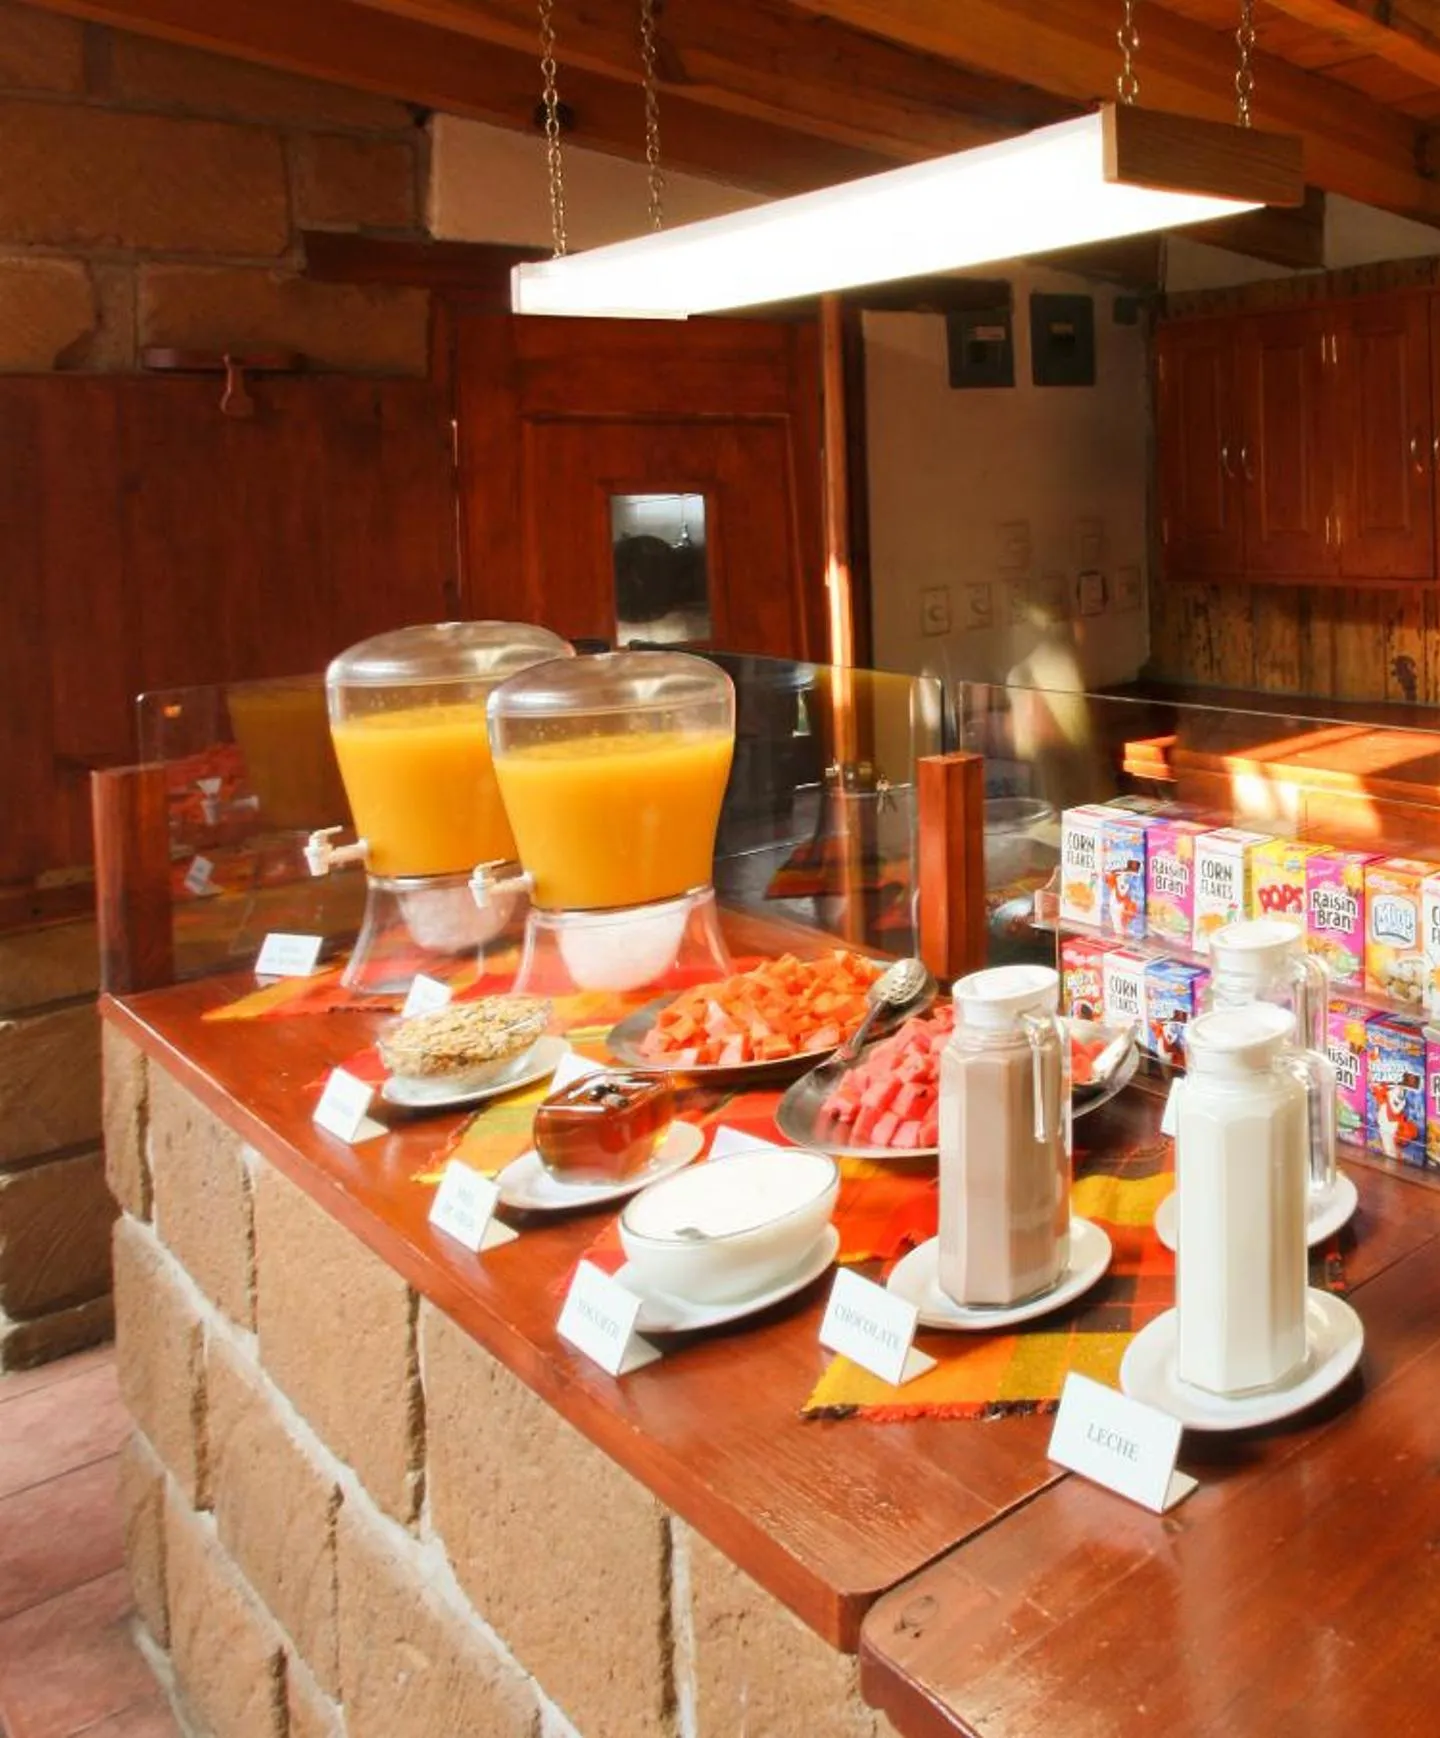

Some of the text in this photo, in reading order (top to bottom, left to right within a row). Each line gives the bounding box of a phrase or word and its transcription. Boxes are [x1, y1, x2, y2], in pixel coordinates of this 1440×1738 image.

[1067, 831, 1095, 851] CORN
[1066, 850, 1095, 869] FLAKES
[1151, 858, 1187, 881] Raisin
[1201, 859, 1232, 881] CORN
[1155, 875, 1184, 895] Bran
[1200, 878, 1233, 900] FLAKES
[1257, 883, 1304, 914] POPS
[1312, 890, 1356, 915] Raisin
[1317, 909, 1351, 931] Bran
[1110, 974, 1138, 998] CORN
[1086, 1422, 1139, 1462] LECHE
